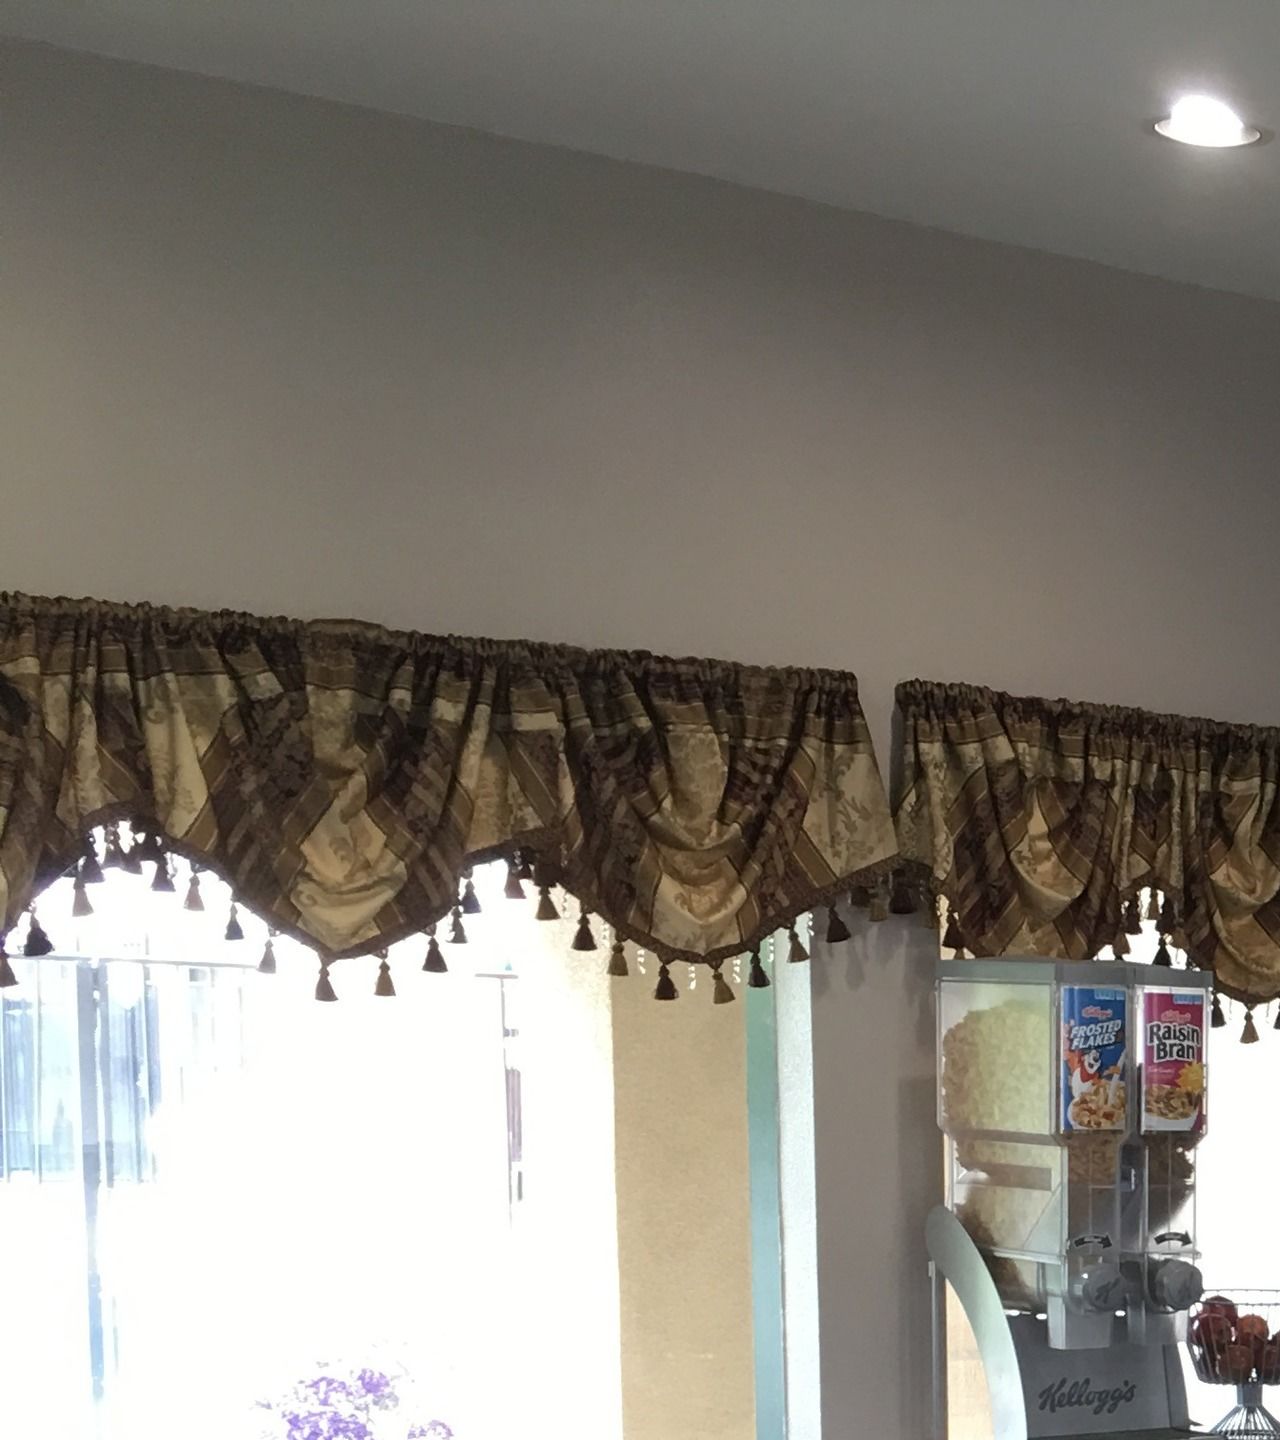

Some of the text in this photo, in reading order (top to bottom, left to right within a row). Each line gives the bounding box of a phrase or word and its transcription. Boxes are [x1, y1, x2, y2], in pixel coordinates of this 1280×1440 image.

[1070, 1020, 1122, 1040] FROSTED
[1149, 1023, 1201, 1046] Raisin
[1072, 1033, 1117, 1050] FLAKES
[1154, 1041, 1196, 1062] Bran
[1038, 1377, 1136, 1415] Kellogg's
